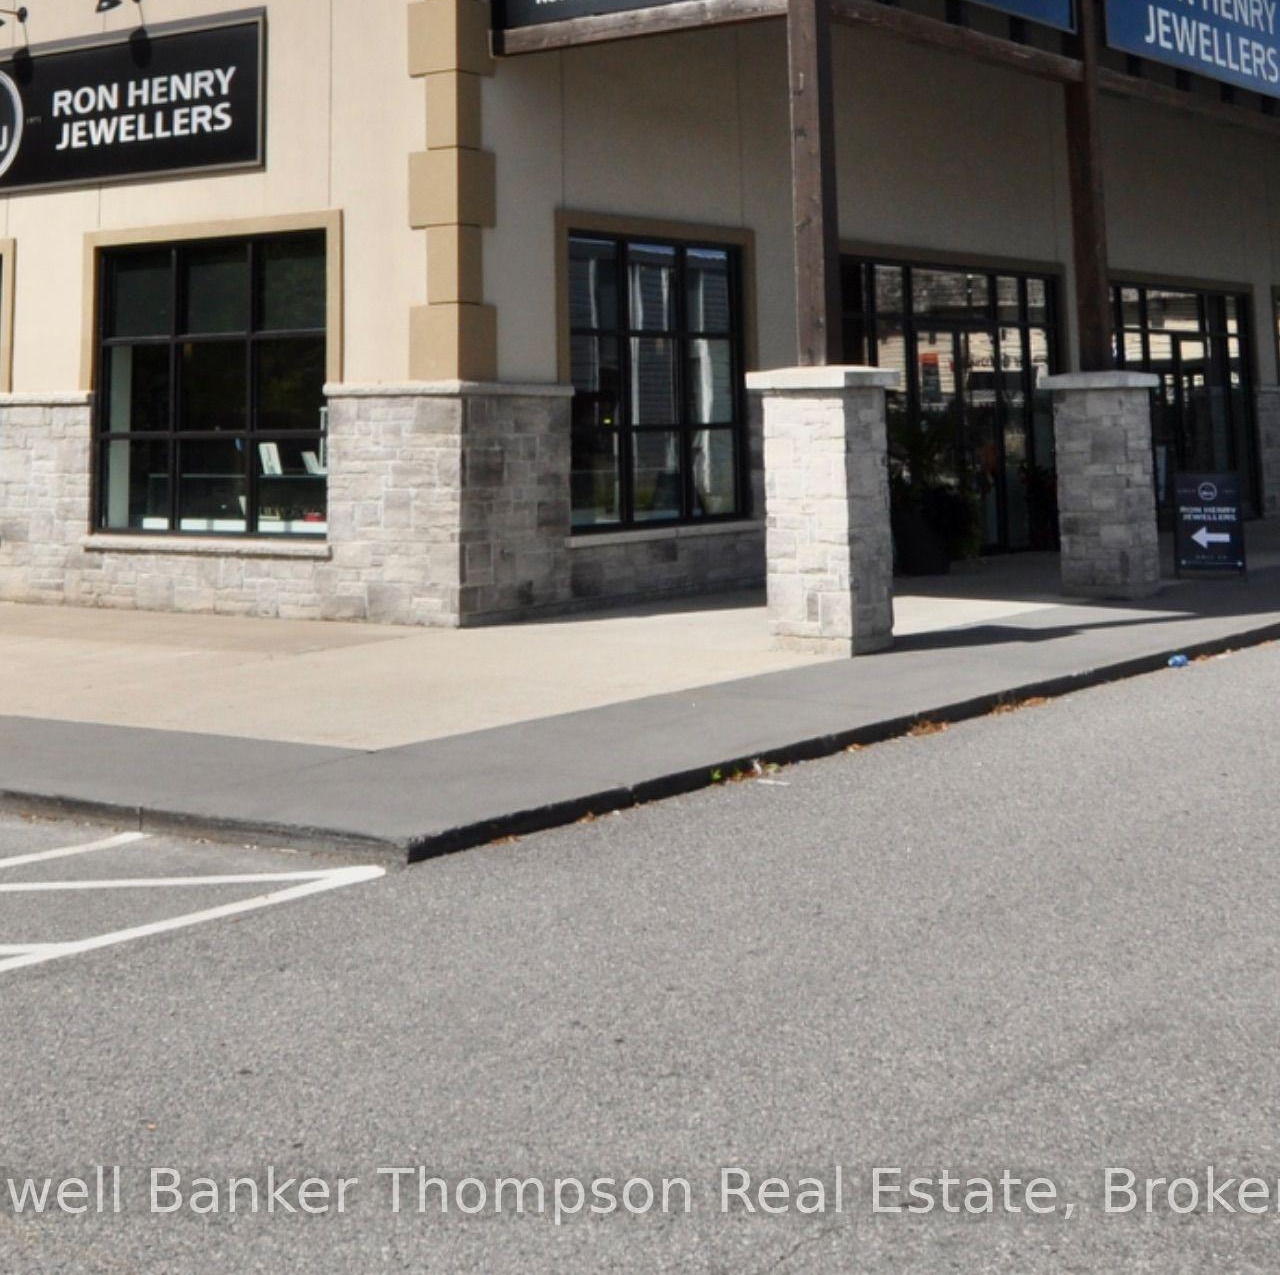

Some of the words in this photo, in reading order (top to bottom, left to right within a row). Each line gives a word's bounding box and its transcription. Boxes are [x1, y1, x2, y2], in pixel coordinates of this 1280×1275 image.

[1144, 4, 1279, 83] JEWELLERS
[52, 82, 119, 117] RON
[127, 66, 237, 107] HENRY
[55, 101, 233, 150] JEWELLERS
